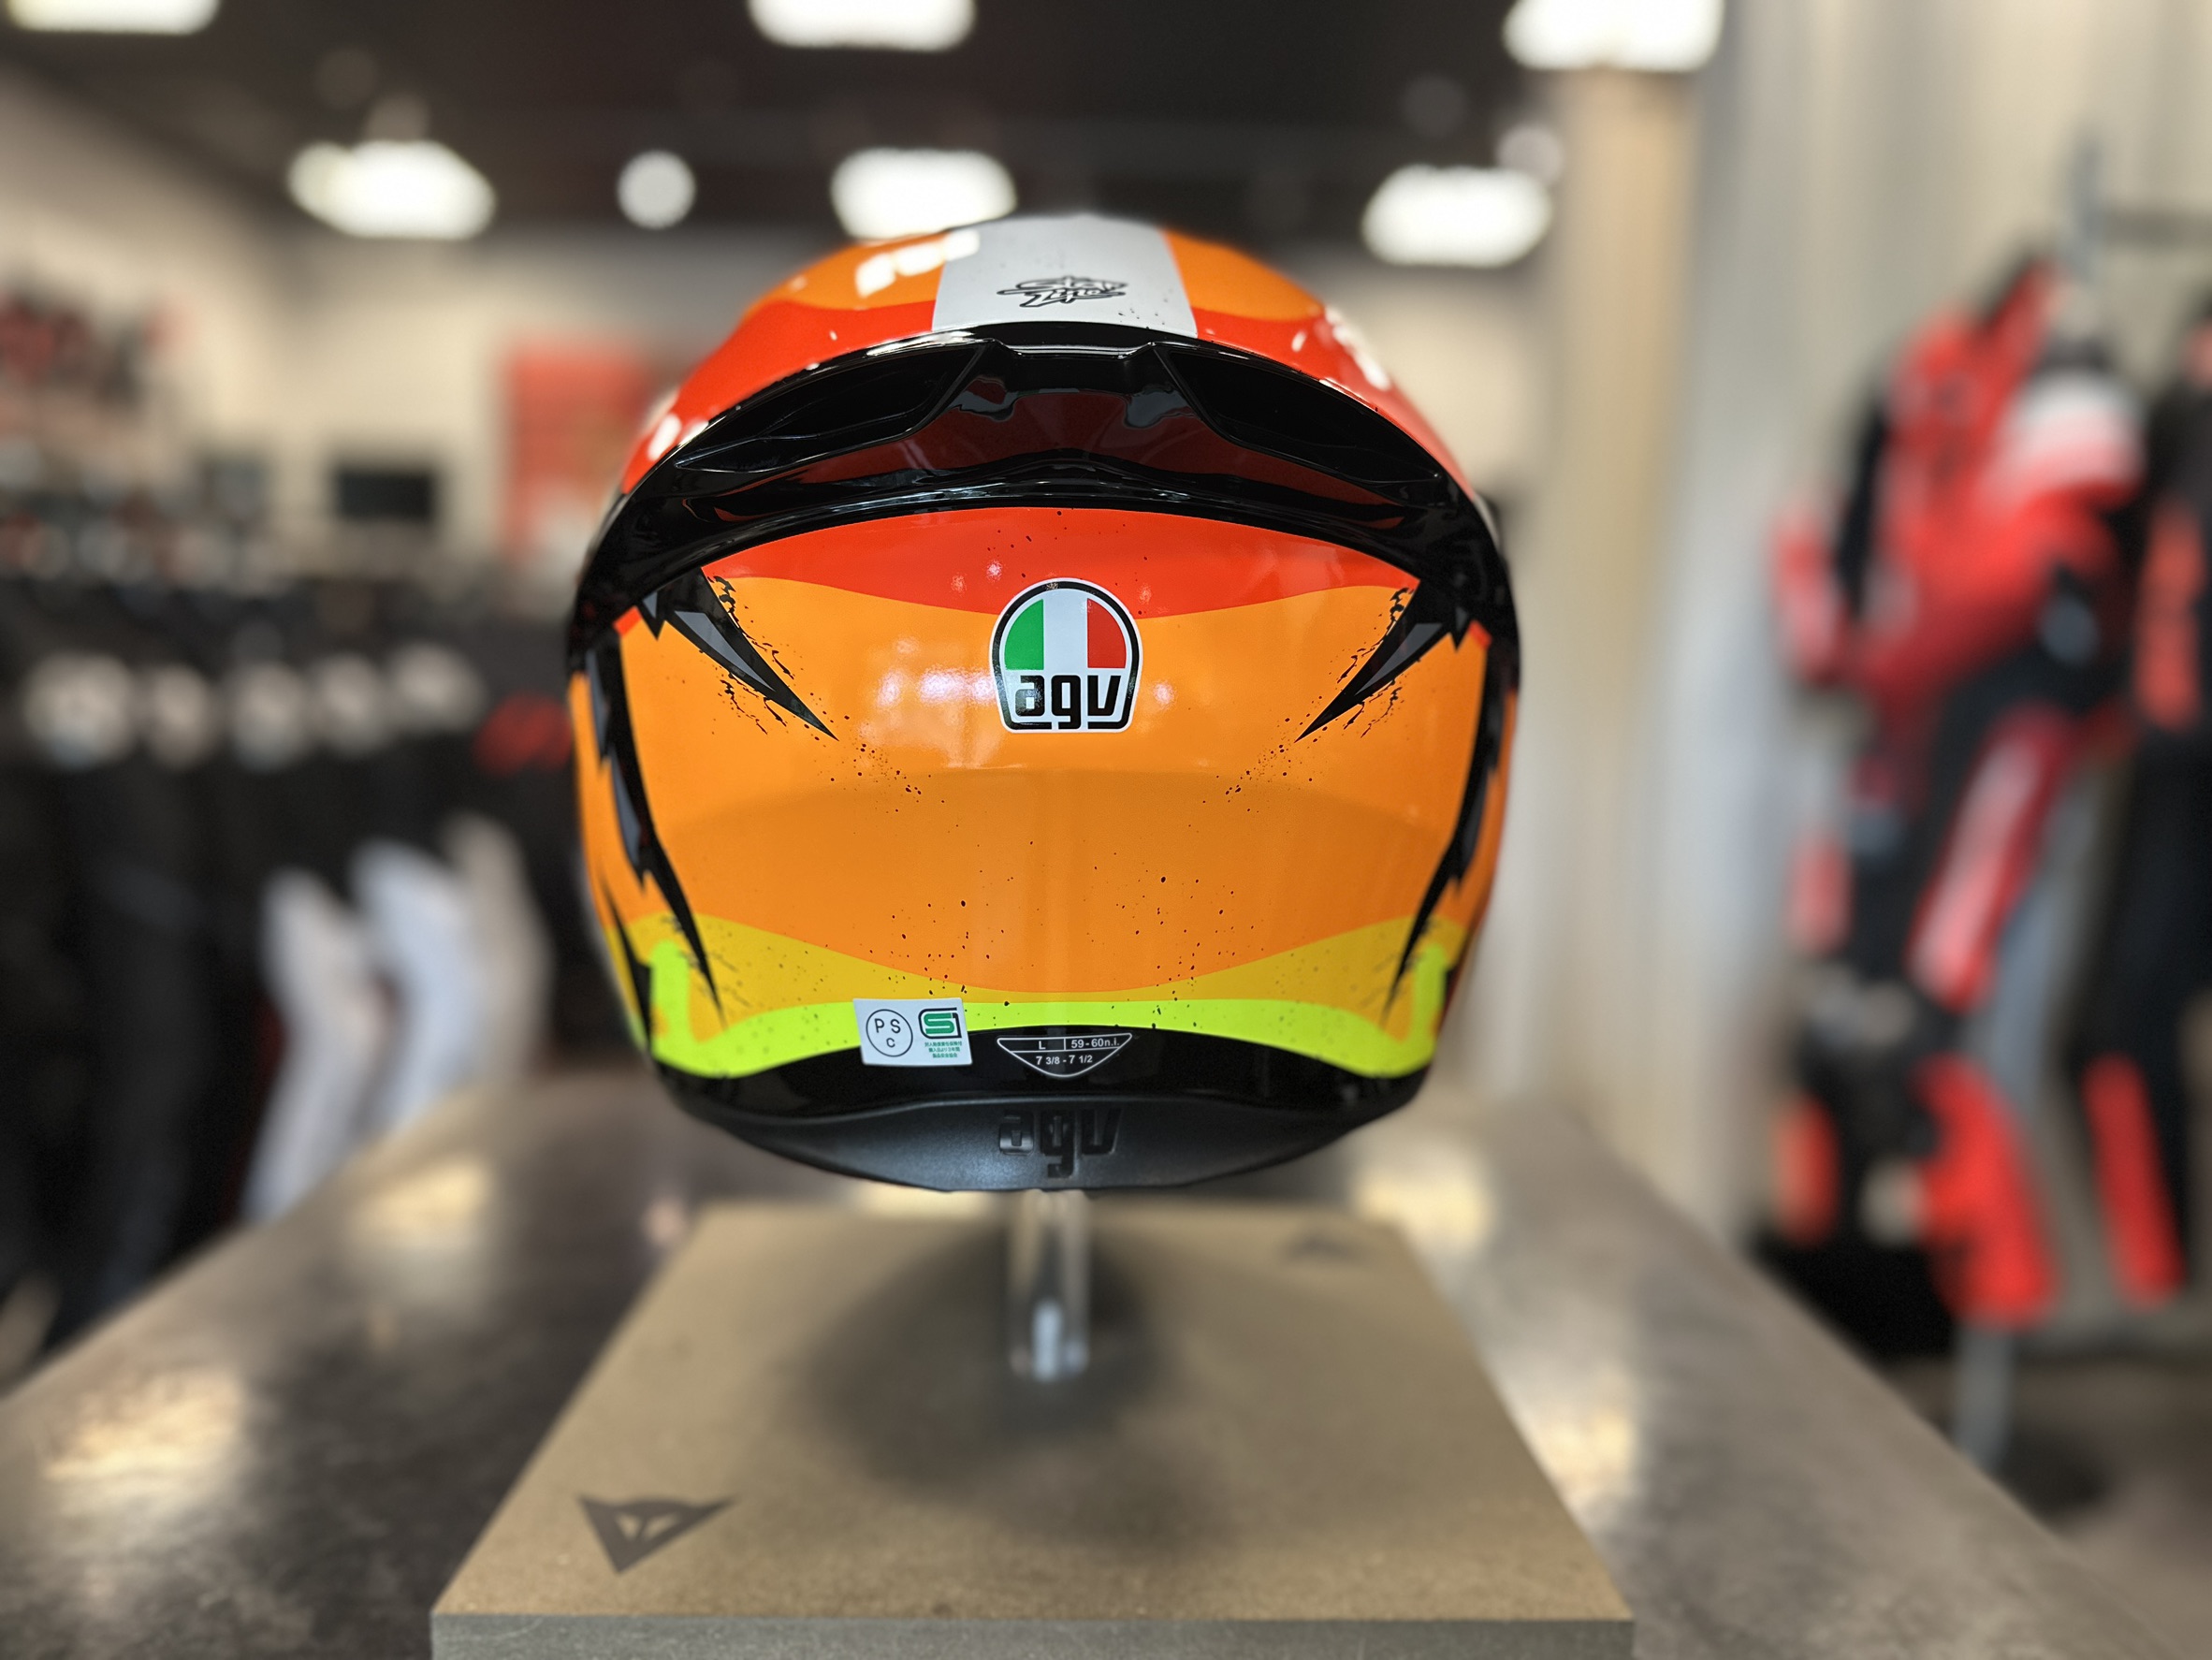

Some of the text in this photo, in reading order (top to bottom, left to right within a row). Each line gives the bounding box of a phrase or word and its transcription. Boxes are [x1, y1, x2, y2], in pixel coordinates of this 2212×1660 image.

[1015, 675, 1122, 729] agv
[1038, 1041, 1046, 1050] L
[998, 1108, 1123, 1179] agv
